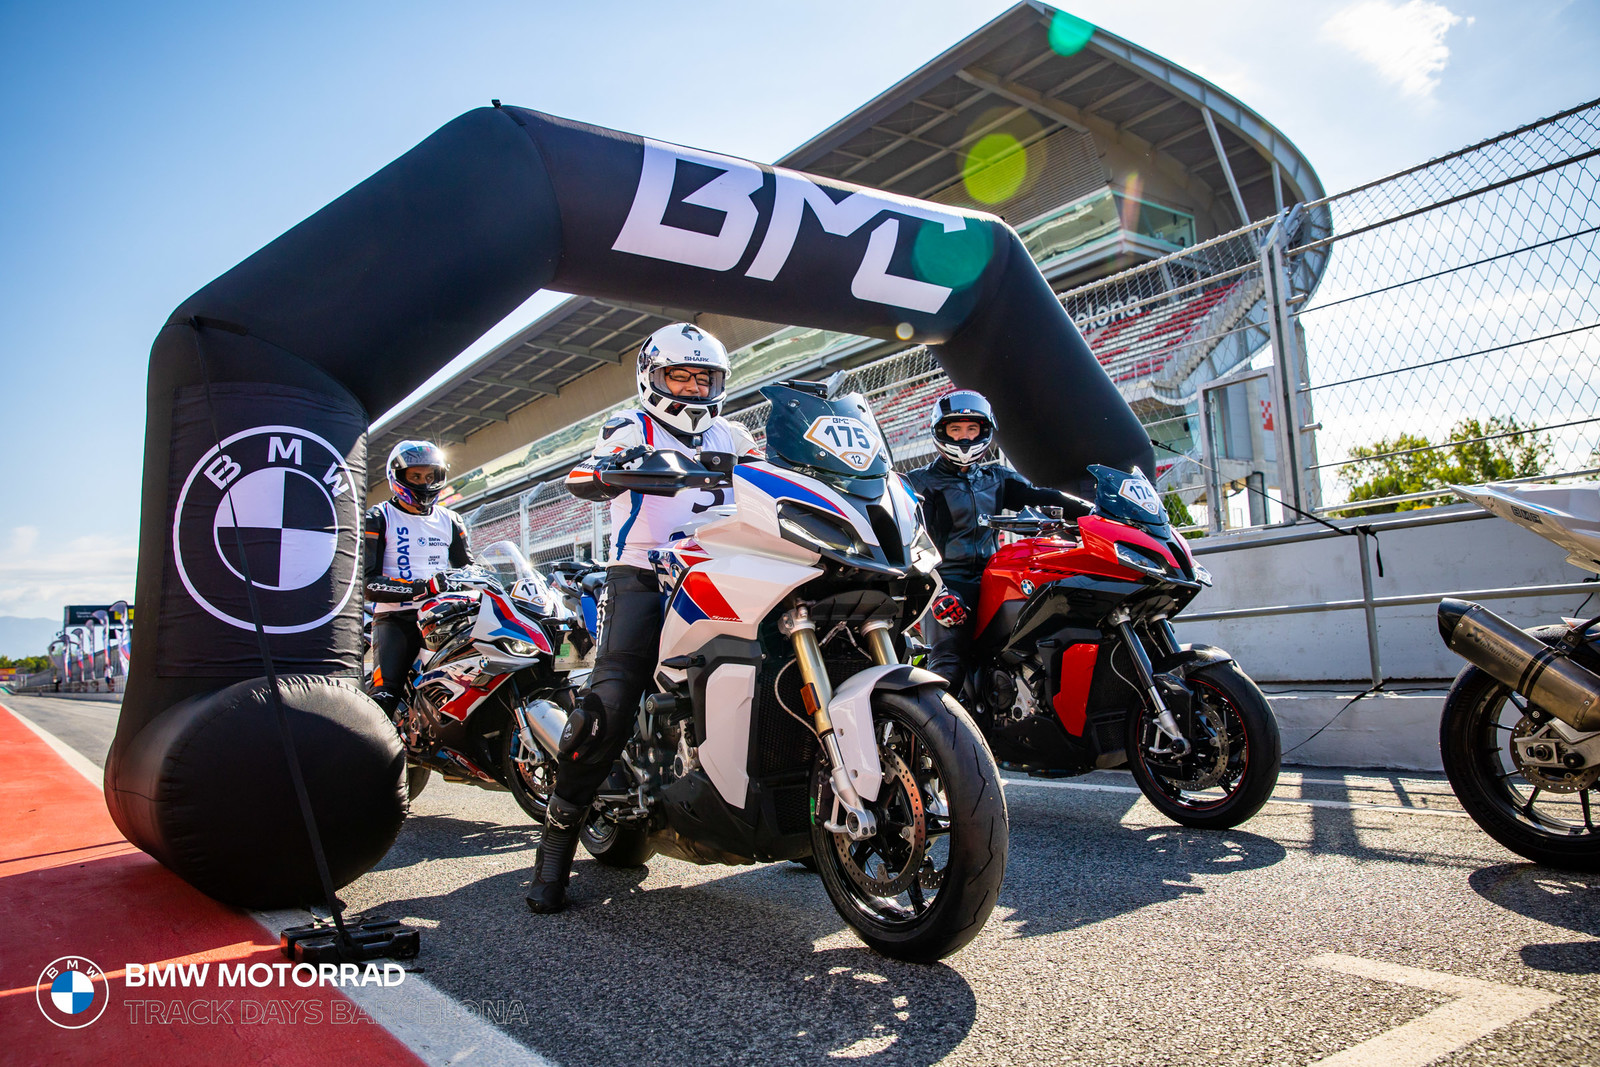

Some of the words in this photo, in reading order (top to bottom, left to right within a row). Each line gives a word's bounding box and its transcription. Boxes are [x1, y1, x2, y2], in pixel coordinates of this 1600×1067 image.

[611, 137, 967, 314] BMC
[824, 425, 871, 449] 175
[204, 436, 350, 498] BMW
[851, 455, 863, 465] 12
